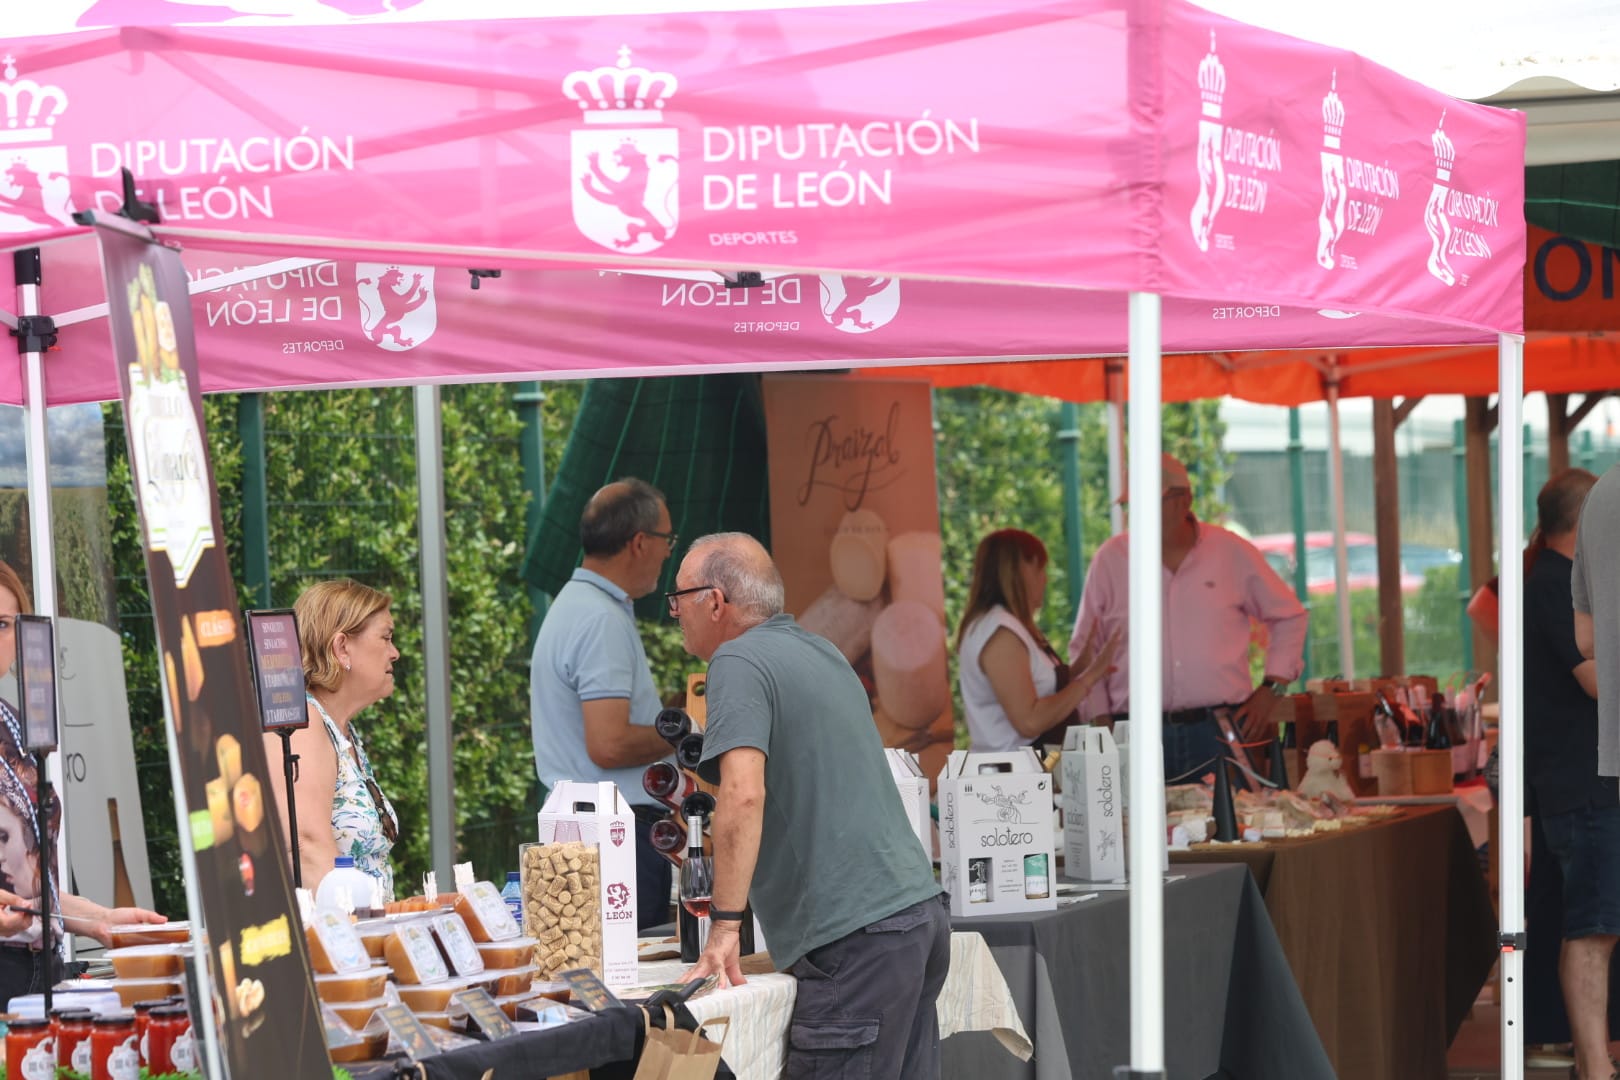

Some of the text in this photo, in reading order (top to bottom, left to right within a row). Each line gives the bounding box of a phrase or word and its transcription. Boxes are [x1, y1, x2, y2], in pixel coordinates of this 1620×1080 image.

[91, 126, 354, 178] DIPUTACIÓN
[703, 109, 980, 162] DIPUTACIÓN
[1223, 128, 1282, 172] DIPUTACIÓN
[157, 176, 273, 220] LEÓN
[703, 160, 892, 210] DE LEÓN
[1345, 157, 1399, 200] DIPUTACIÓN
[1447, 189, 1499, 228] DIPUTACIÓN
[709, 230, 798, 246] DEPORTES
[1096, 765, 1113, 817] solotero
[980, 826, 1034, 848] solotero
[606, 910, 633, 920] LEÓN
